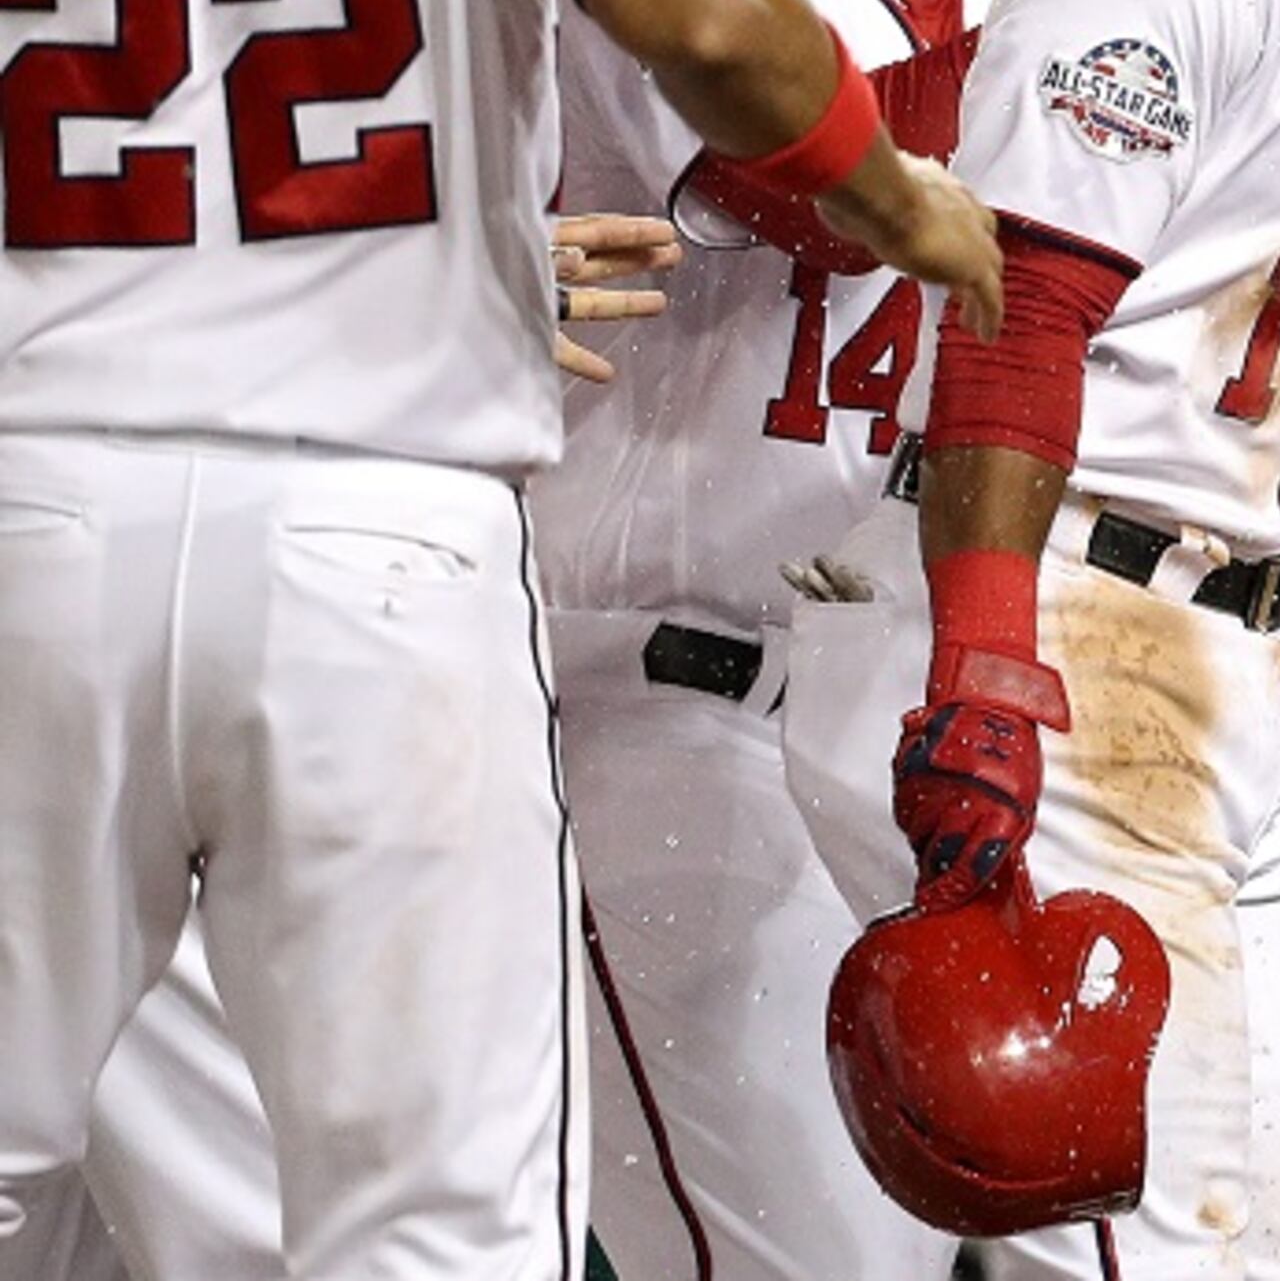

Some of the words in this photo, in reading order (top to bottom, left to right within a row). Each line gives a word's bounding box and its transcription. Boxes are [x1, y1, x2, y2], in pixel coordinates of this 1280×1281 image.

[1041, 60, 1145, 116] ALL-STAR
[1143, 96, 1193, 141] GAME
[762, 261, 924, 455] 14
